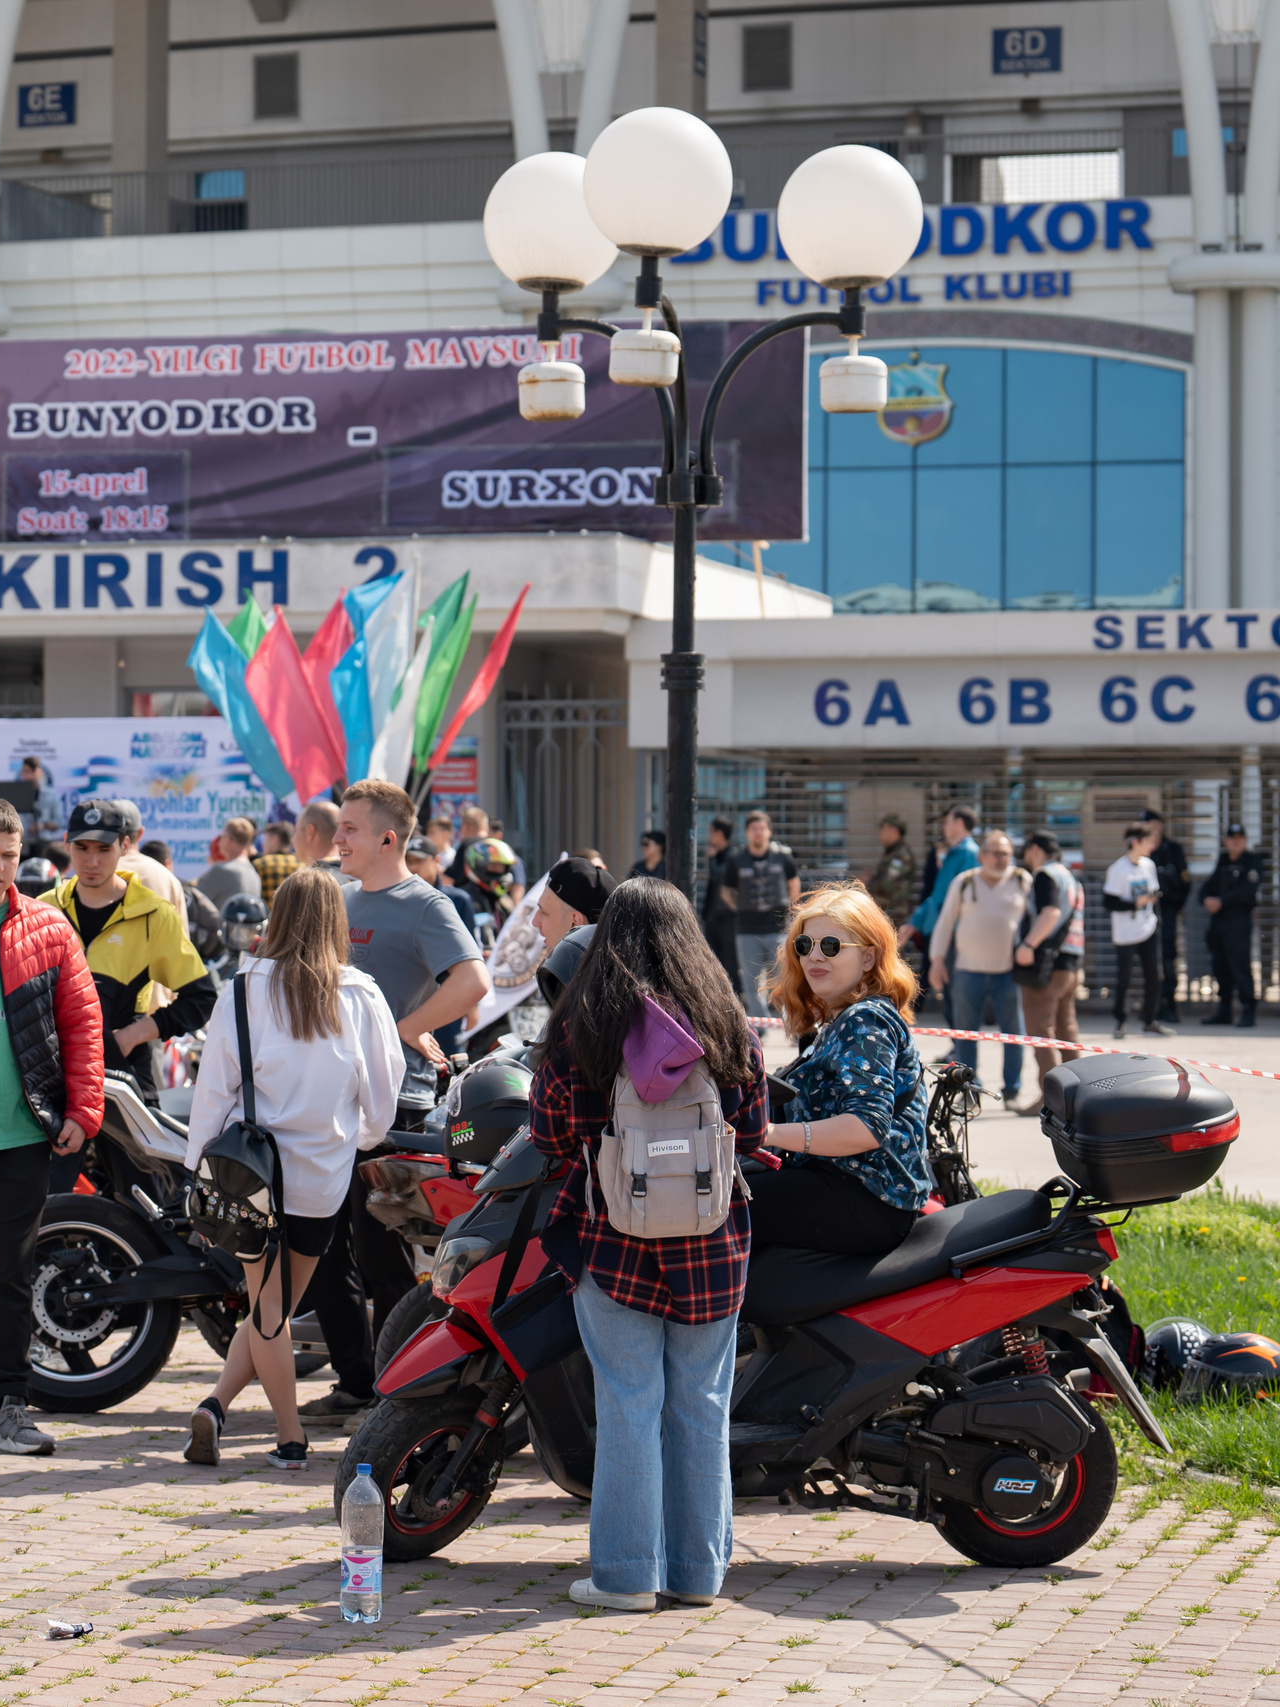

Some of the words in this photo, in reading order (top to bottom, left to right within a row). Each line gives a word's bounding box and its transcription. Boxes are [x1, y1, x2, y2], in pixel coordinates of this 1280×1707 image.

[1004, 30, 1047, 57] 6D
[27, 85, 62, 112] 6E
[945, 271, 1072, 300] KLUBI
[65, 347, 243, 376] 2022-YILGI
[255, 342, 395, 372] FUTBOL
[10, 401, 314, 436] BUNYODKOR
[39, 469, 146, 498] 15-aprel
[18, 509, 87, 533] Soat:
[100, 507, 167, 530] 18:15
[354, 546, 397, 585] 2
[1093, 614, 1280, 650] SEKT
[814, 678, 910, 726] 6A
[958, 677, 1051, 725] 6B
[1099, 675, 1195, 723] 6C
[652, 1144, 684, 1153] Hivison
